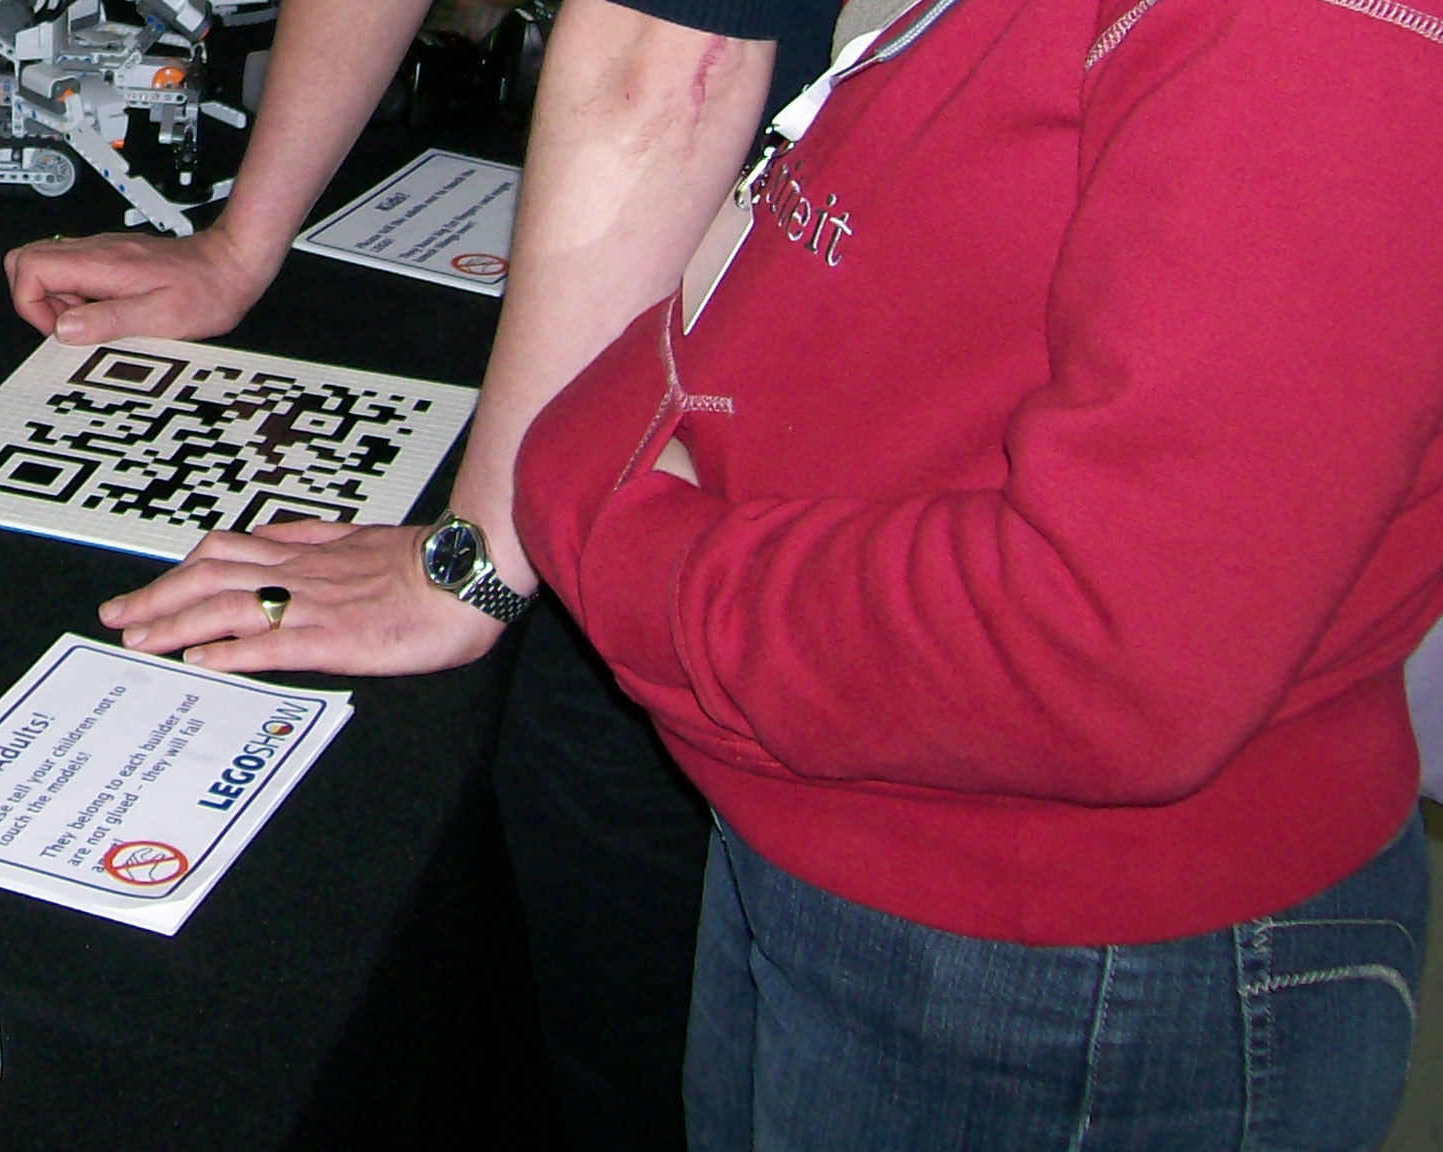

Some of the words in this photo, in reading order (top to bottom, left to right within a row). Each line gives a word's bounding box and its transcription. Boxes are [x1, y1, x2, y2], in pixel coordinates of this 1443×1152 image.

[7, 783, 32, 804] tell
[27, 758, 57, 785] your
[52, 715, 97, 758] children
[93, 697, 116, 716] not
[109, 684, 127, 698] to
[27, 793, 52, 814] the
[47, 751, 93, 794] models!
[39, 831, 78, 859] They
[66, 791, 115, 830] belong
[105, 778, 123, 791] to
[119, 751, 147, 778] each
[139, 715, 181, 755] builder
[176, 693, 200, 714] and
[67, 848, 92, 868] are
[87, 826, 111, 846] not
[105, 792, 139, 826] glued
[141, 759, 171, 785] they
[163, 736, 189, 759] will
[182, 717, 206, 737] fall
